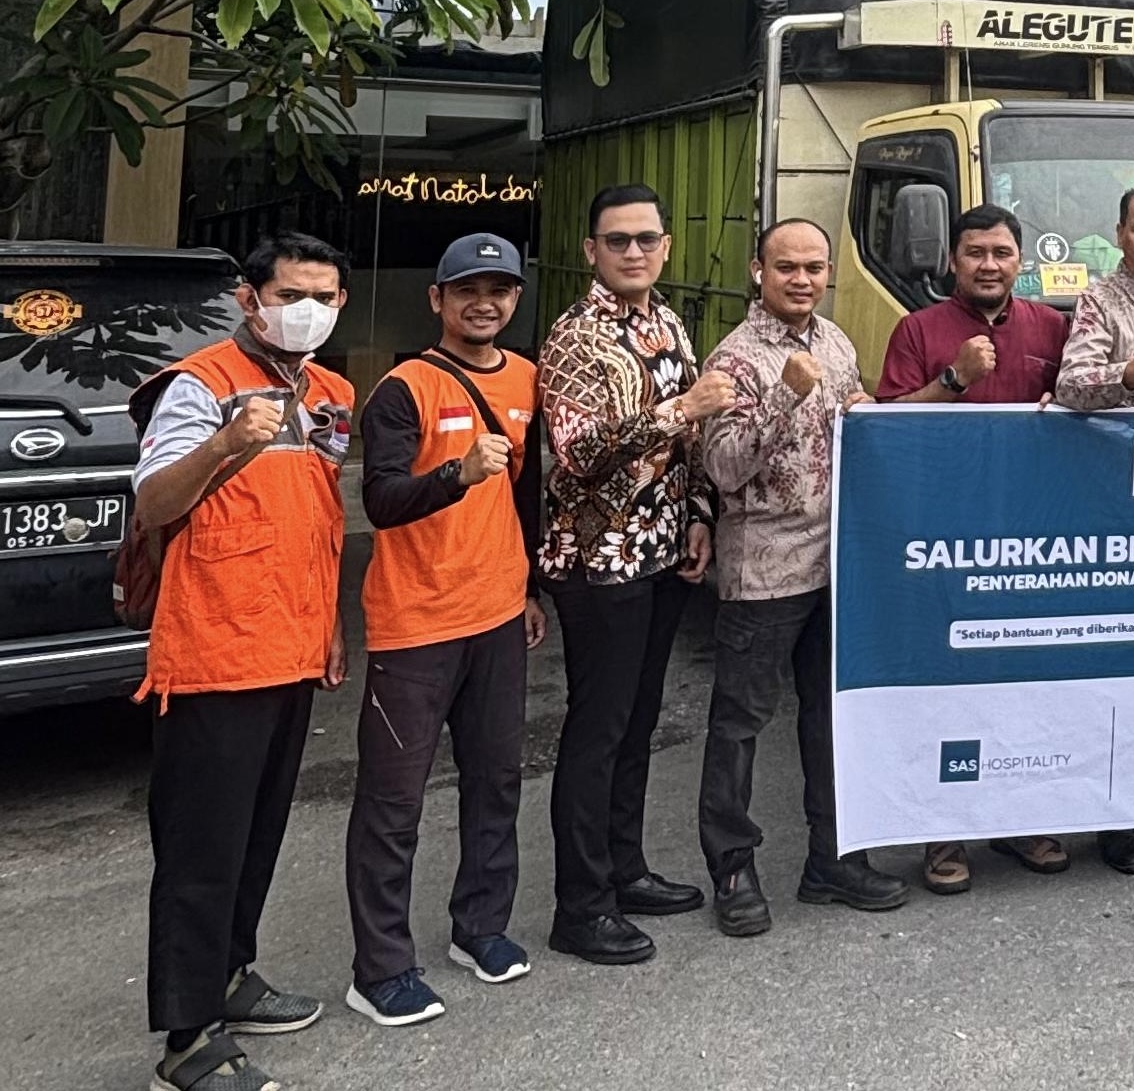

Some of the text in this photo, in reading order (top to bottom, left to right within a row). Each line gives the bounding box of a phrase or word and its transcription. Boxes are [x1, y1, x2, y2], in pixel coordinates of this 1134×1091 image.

[976, 9, 1134, 44] ALEGUTE
[420, 172, 497, 204] Natal
[2, 499, 120, 535] 1383 JP
[905, 535, 1098, 570] SALURKAN
[965, 572, 1089, 592] PENYERAHAN
[1002, 627, 1053, 639] bantuan
[1056, 626, 1084, 638] yang
[948, 753, 1072, 773] SAS HOSPITALITY
